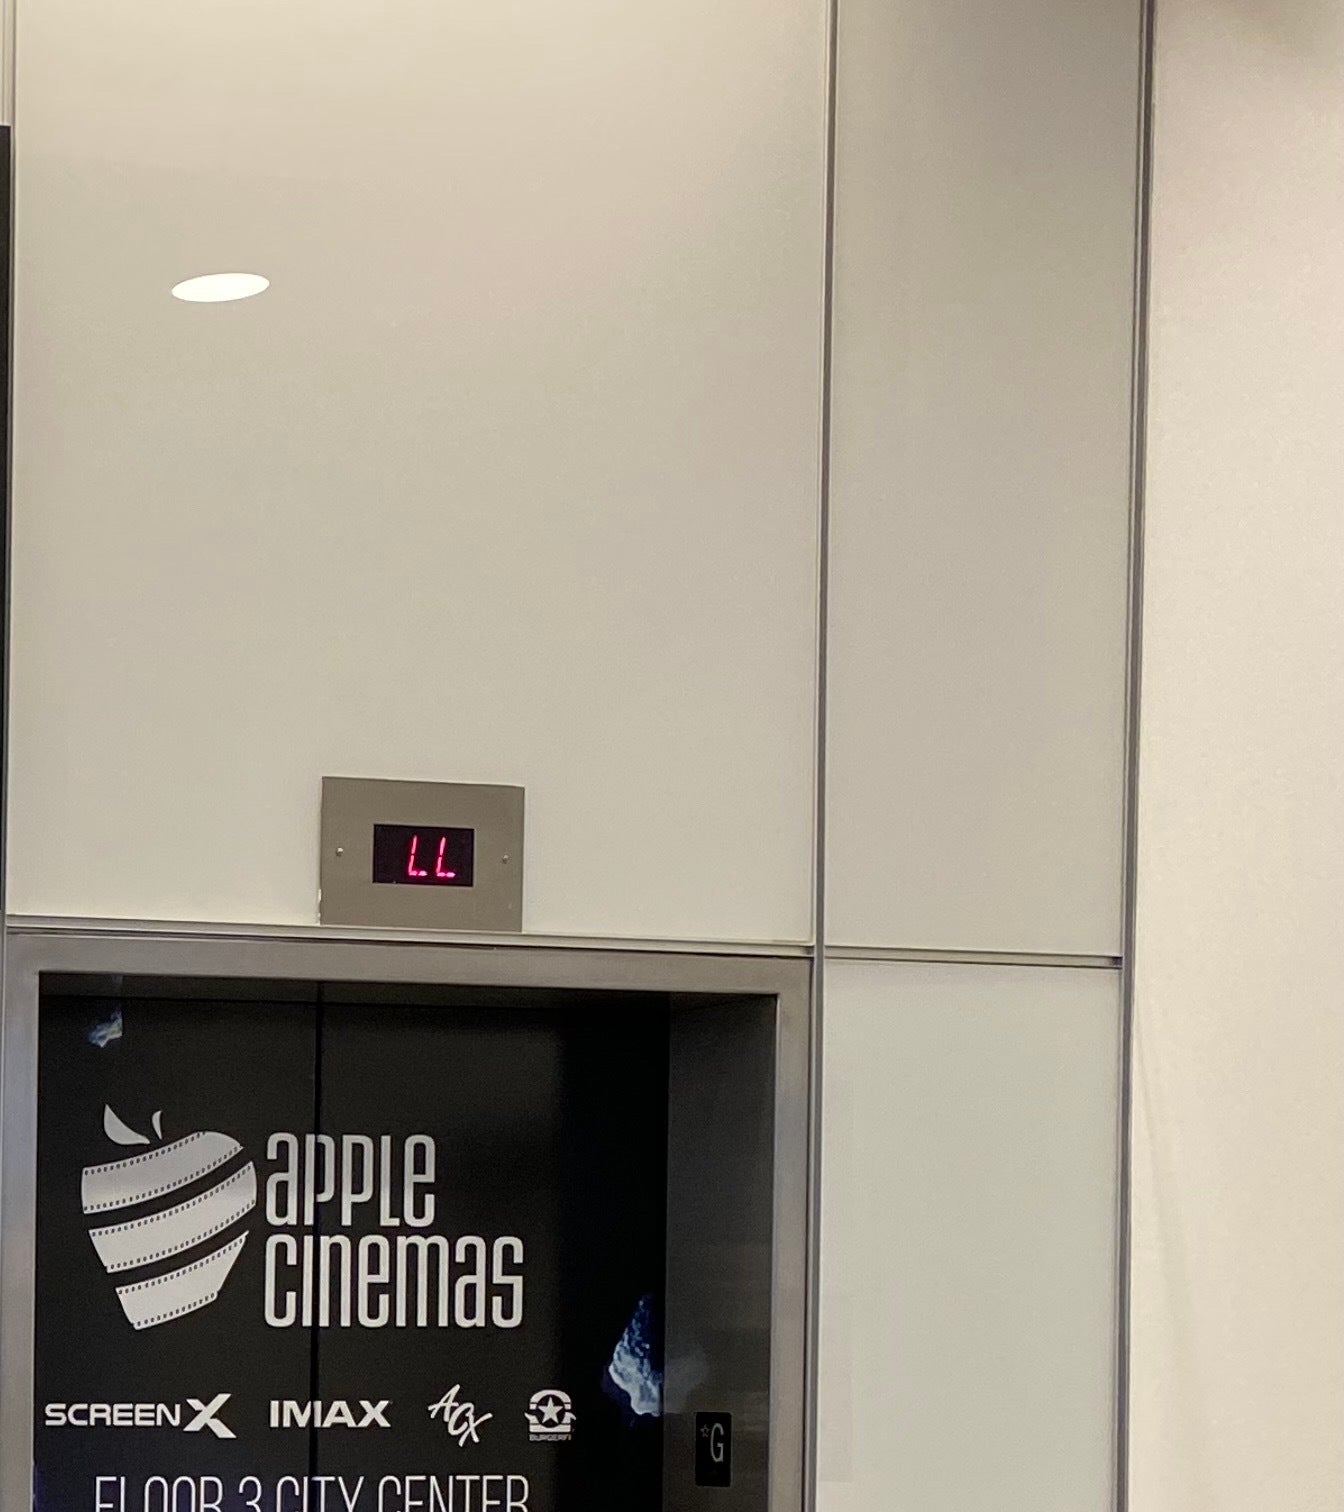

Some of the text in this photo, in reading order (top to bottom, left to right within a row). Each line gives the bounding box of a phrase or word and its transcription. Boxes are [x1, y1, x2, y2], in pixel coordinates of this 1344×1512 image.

[408, 835, 456, 878] LL
[264, 1233, 524, 1329] cinemas
[44, 1392, 237, 1439] SCREENX
[269, 1399, 391, 1429] IMAX
[710, 1422, 725, 1463] G
